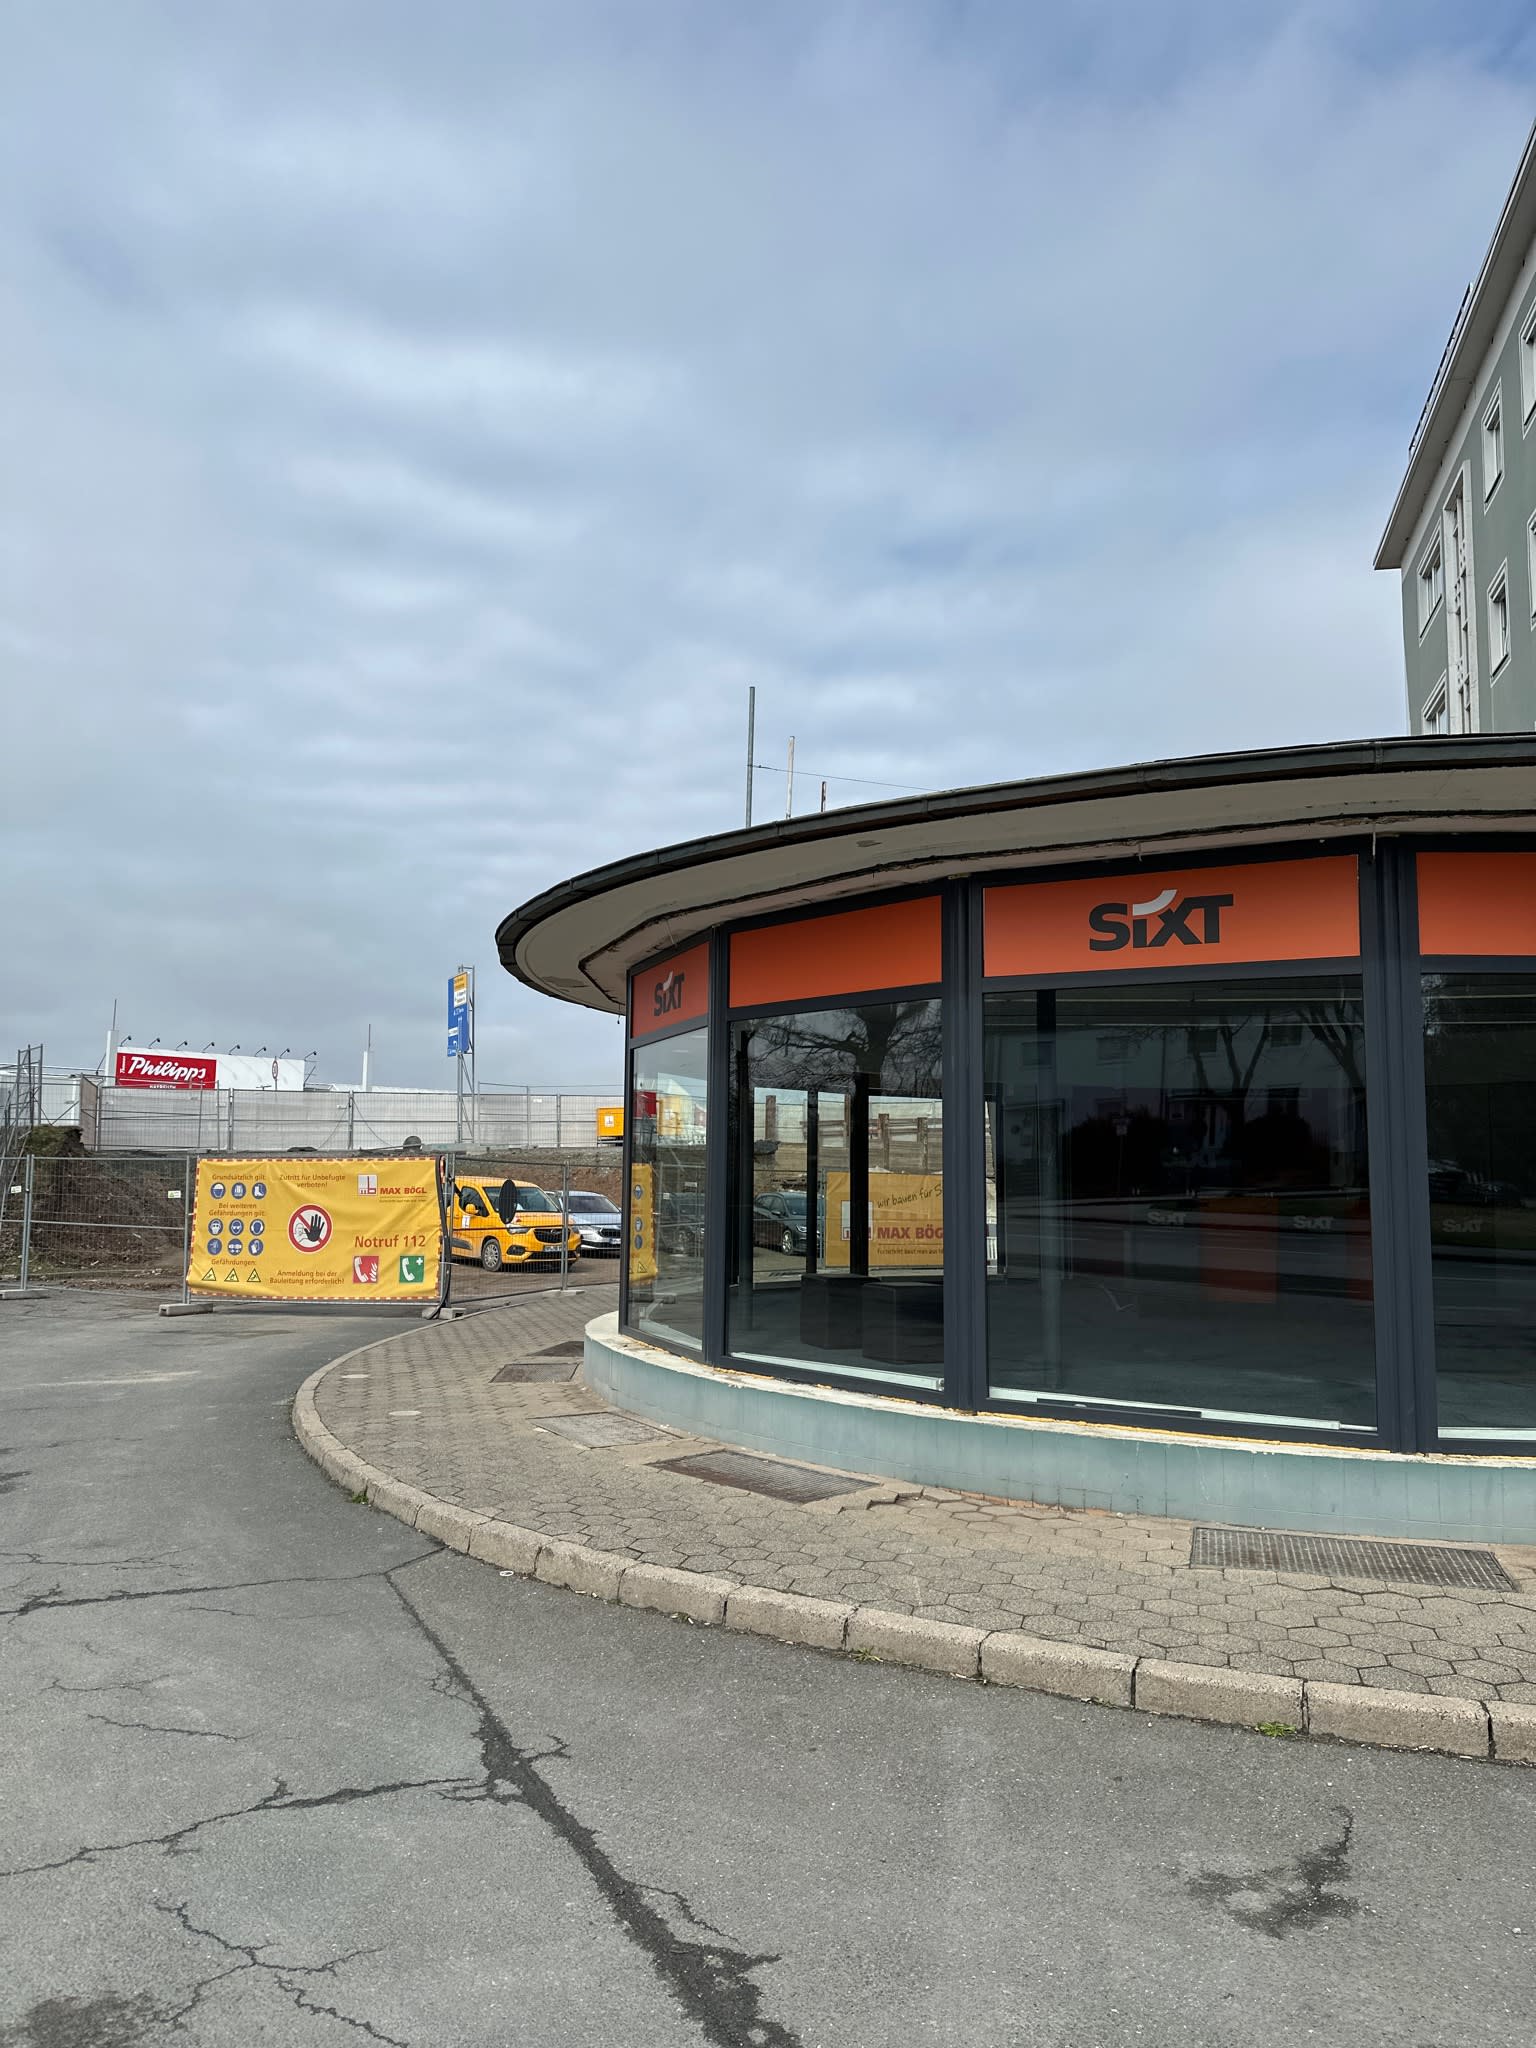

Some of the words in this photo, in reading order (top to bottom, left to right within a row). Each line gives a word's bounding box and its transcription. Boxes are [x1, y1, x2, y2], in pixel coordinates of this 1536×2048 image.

[128, 1056, 206, 1081] Philipps
[312, 1174, 346, 1182] Unbefugte
[380, 1187, 401, 1195] MAX
[404, 1186, 427, 1195] BÖGL
[877, 1198, 890, 1208] wir
[892, 1193, 918, 1206] bauen
[919, 1187, 933, 1199] für
[208, 1209, 253, 1217] Gefährdungen
[877, 1227, 911, 1240] MAX
[915, 1224, 944, 1240] BÖG
[354, 1235, 400, 1248] Notruf
[403, 1235, 426, 1248] 112
[211, 1258, 257, 1266] Gefährdungen:
[277, 1270, 314, 1278] Anmeldung
[269, 1277, 304, 1285] Bauleitung
[304, 1277, 345, 1286] erforderlich!
